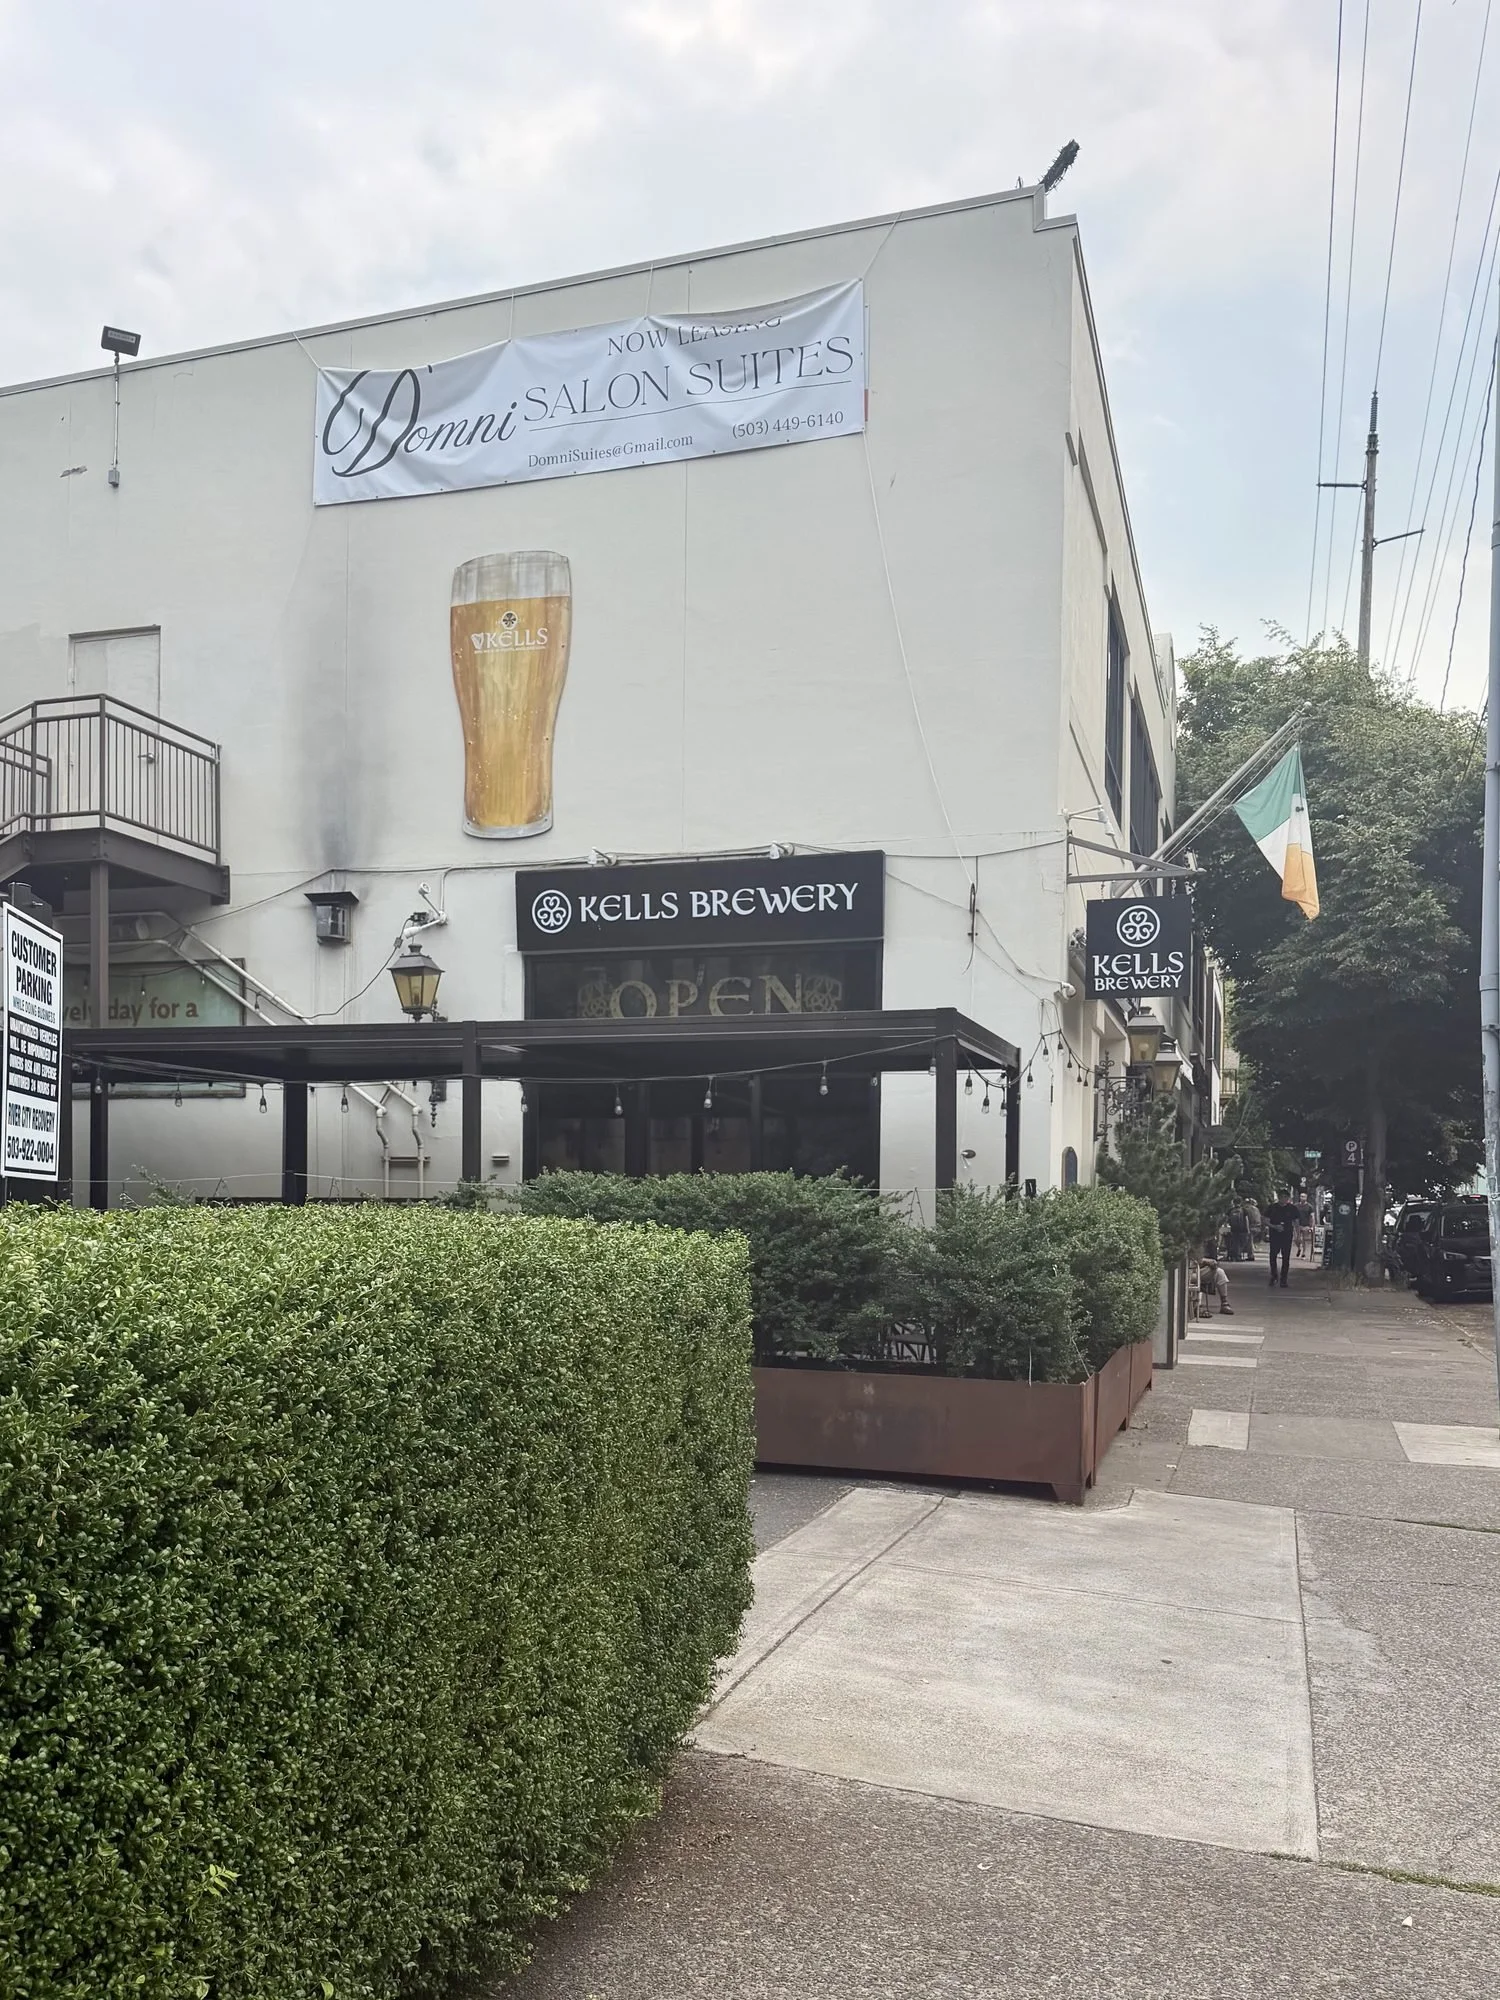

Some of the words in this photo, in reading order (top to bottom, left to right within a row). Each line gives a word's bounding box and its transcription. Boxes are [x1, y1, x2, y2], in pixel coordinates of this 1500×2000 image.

[608, 328, 668, 356] NOW
[678, 315, 782, 346] LEASING
[524, 365, 670, 421] SALON
[686, 336, 854, 395] SUITES
[732, 418, 769, 440] (503)
[772, 411, 844, 432] 449-6140
[528, 434, 693, 468] DomniSuites@Gmail.com
[485, 627, 548, 649] KELLS
[578, 891, 679, 922] KELLS
[689, 882, 858, 918] BREWERY
[12, 930, 57, 978] CUSTOMER
[1092, 951, 1184, 976] KELLS
[16, 965, 53, 1006] PARKING
[609, 972, 803, 1018] OPEN
[1094, 974, 1182, 991] BREWERY
[37, 1006, 56, 1024] BUSINESS
[108, 998, 143, 1027] day
[150, 997, 180, 1019] for
[185, 1001, 199, 1018] a
[9, 1034, 20, 1052] WILL
[20, 1039, 27, 1054] BE
[30, 1078, 37, 1093] 24
[37, 1079, 50, 1096] HOURS
[50, 1083, 57, 1097] BY
[8, 1102, 21, 1127] RIVER
[21, 1105, 32, 1129] CITY
[32, 1107, 55, 1133] RECOVERY
[7, 1135, 54, 1164] 503-922-0004
[1347, 1153, 1356, 1162] 4
